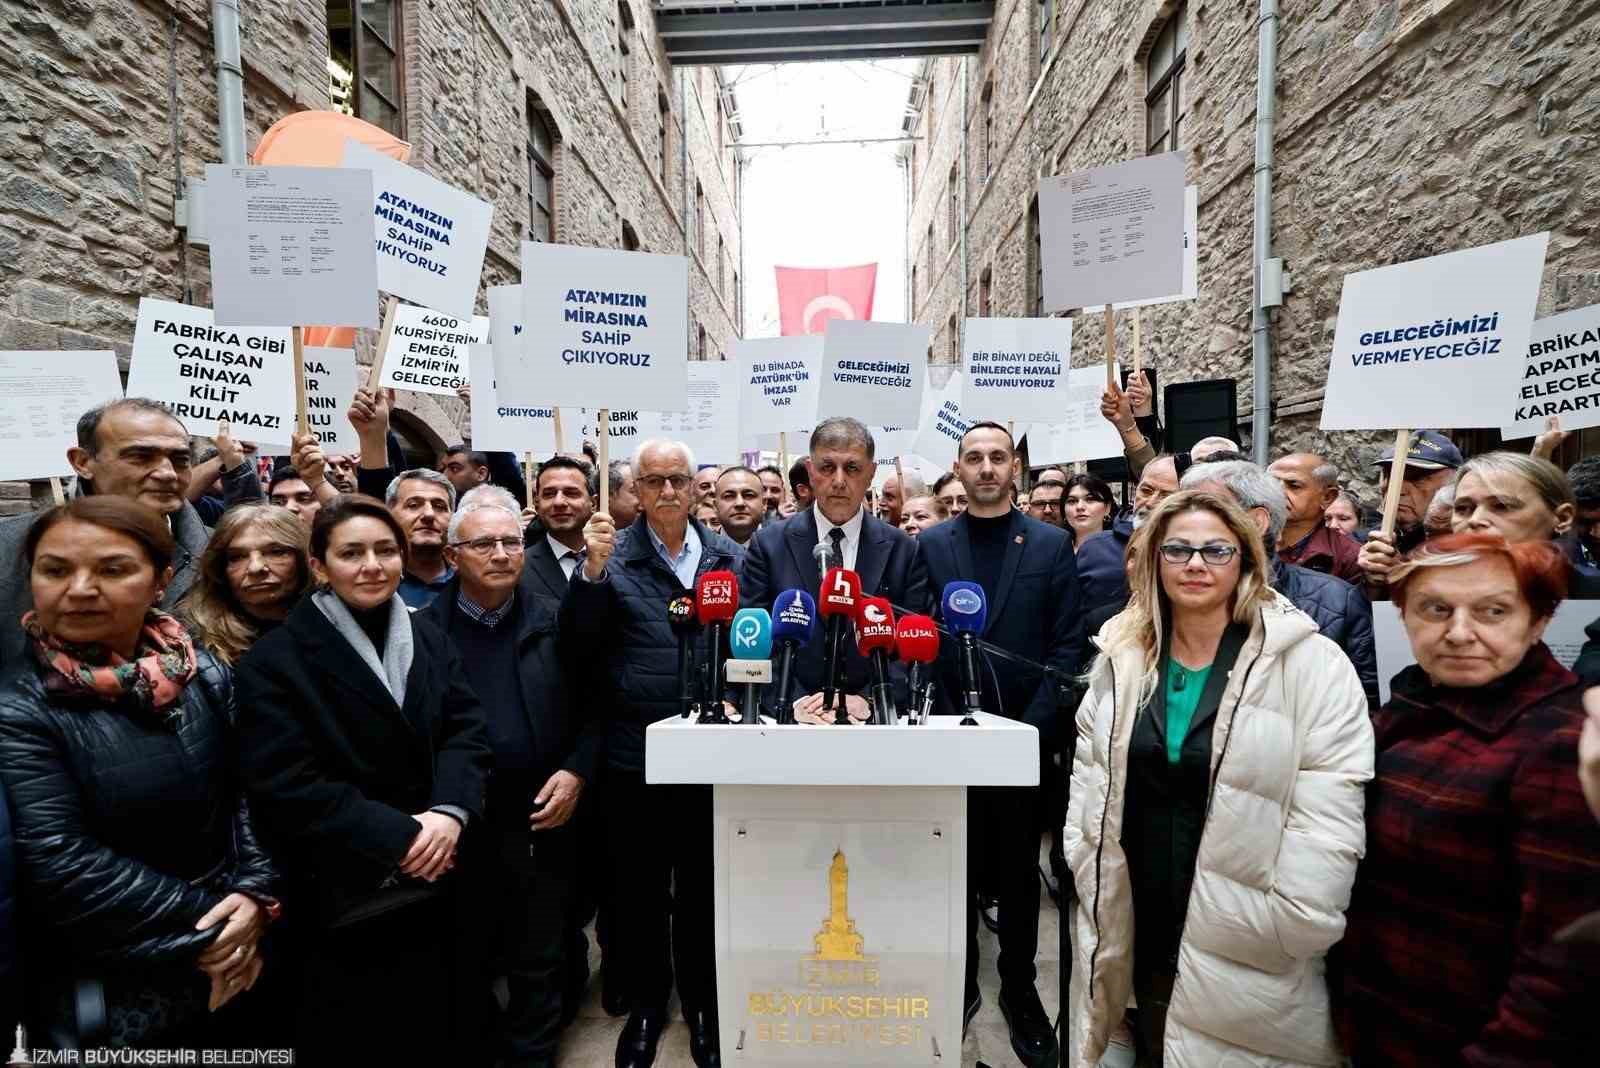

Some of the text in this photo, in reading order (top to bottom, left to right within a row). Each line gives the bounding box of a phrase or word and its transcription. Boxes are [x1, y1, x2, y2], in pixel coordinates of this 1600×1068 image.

[379, 191, 453, 230] ATA'MIZIN
[374, 204, 450, 246] MİRASINA
[387, 227, 433, 252] SAHİP
[376, 239, 447, 277] IKIYORUZ
[565, 289, 647, 308] ATA'MIZIN
[422, 315, 458, 329] 4600
[564, 306, 648, 328] MİRASINA
[153, 320, 286, 354] FABRİKA GİBİ
[394, 324, 479, 345] KURSİYERİN
[581, 329, 631, 345] SAHİP
[1359, 311, 1498, 346] GELECEĞİMİZİ
[1351, 337, 1501, 367] VERMEYECEĞİZ
[1526, 328, 1600, 359] BRİKA
[173, 343, 263, 369] ÇALIŞAN
[400, 353, 459, 374] İZMİR'İN
[562, 349, 651, 367] ÇIKIYORUZ
[972, 351, 1060, 362] BİR BİNAYI DEĞİL
[1524, 350, 1600, 379] APATM
[180, 362, 252, 387] BİNAYA
[752, 361, 805, 373] BU BİNADA
[838, 360, 910, 375] GELECEĞİMİZİ
[970, 364, 1061, 376] BİNLERCE HAYALİ
[750, 371, 809, 385] ATATÜRK'ÜN
[834, 373, 912, 388] VERMEYECEĞİZ
[974, 378, 1056, 388] SAVUNUYORUZ
[189, 383, 240, 403] KİLİT
[764, 385, 797, 396] İMZASI
[771, 398, 791, 407] VAR
[159, 400, 280, 429] RULAMAZ!
[935, 422, 963, 442] SAVU
[863, 622, 892, 633] anka
